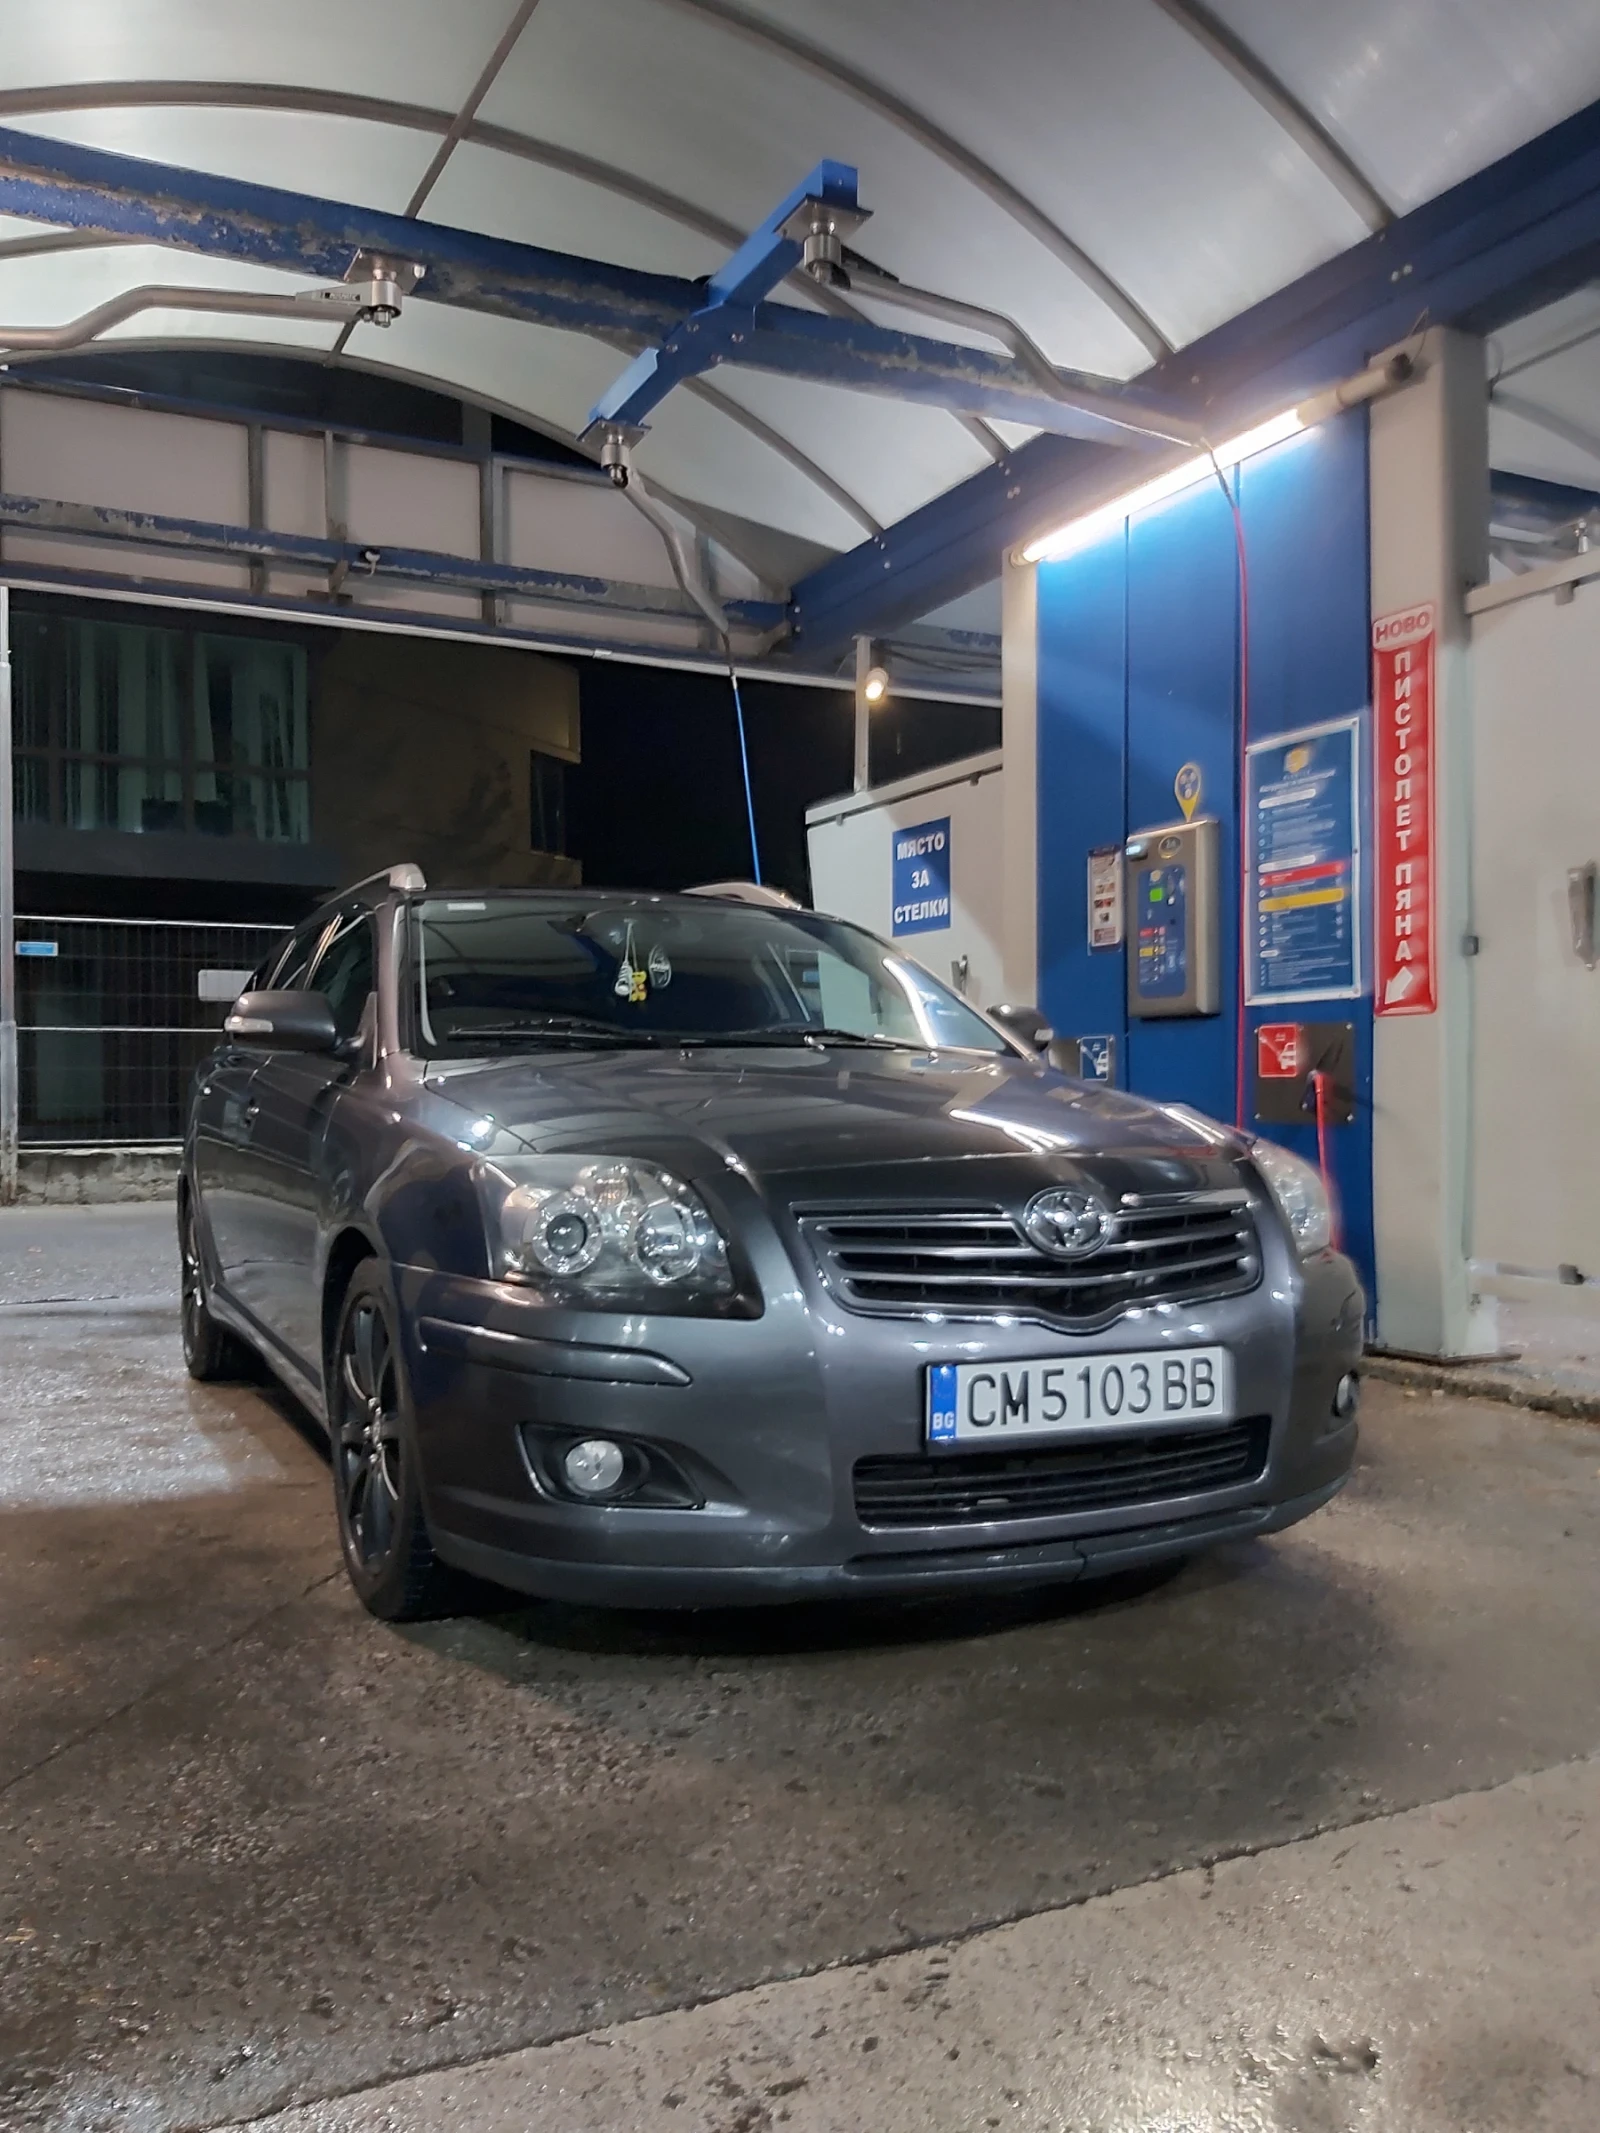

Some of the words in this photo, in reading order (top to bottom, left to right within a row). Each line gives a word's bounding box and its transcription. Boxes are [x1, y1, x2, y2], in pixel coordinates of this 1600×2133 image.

[1375, 611, 1430, 644] НОВО
[1394, 651, 1412, 851] ПИСТОЛЕТ
[896, 832, 945, 860] МЯСТО
[911, 869, 930, 889] ЗА
[894, 897, 949, 924] СТЕЛКИ
[1395, 863, 1413, 962] ПЯНА
[932, 1412, 955, 1430] BG
